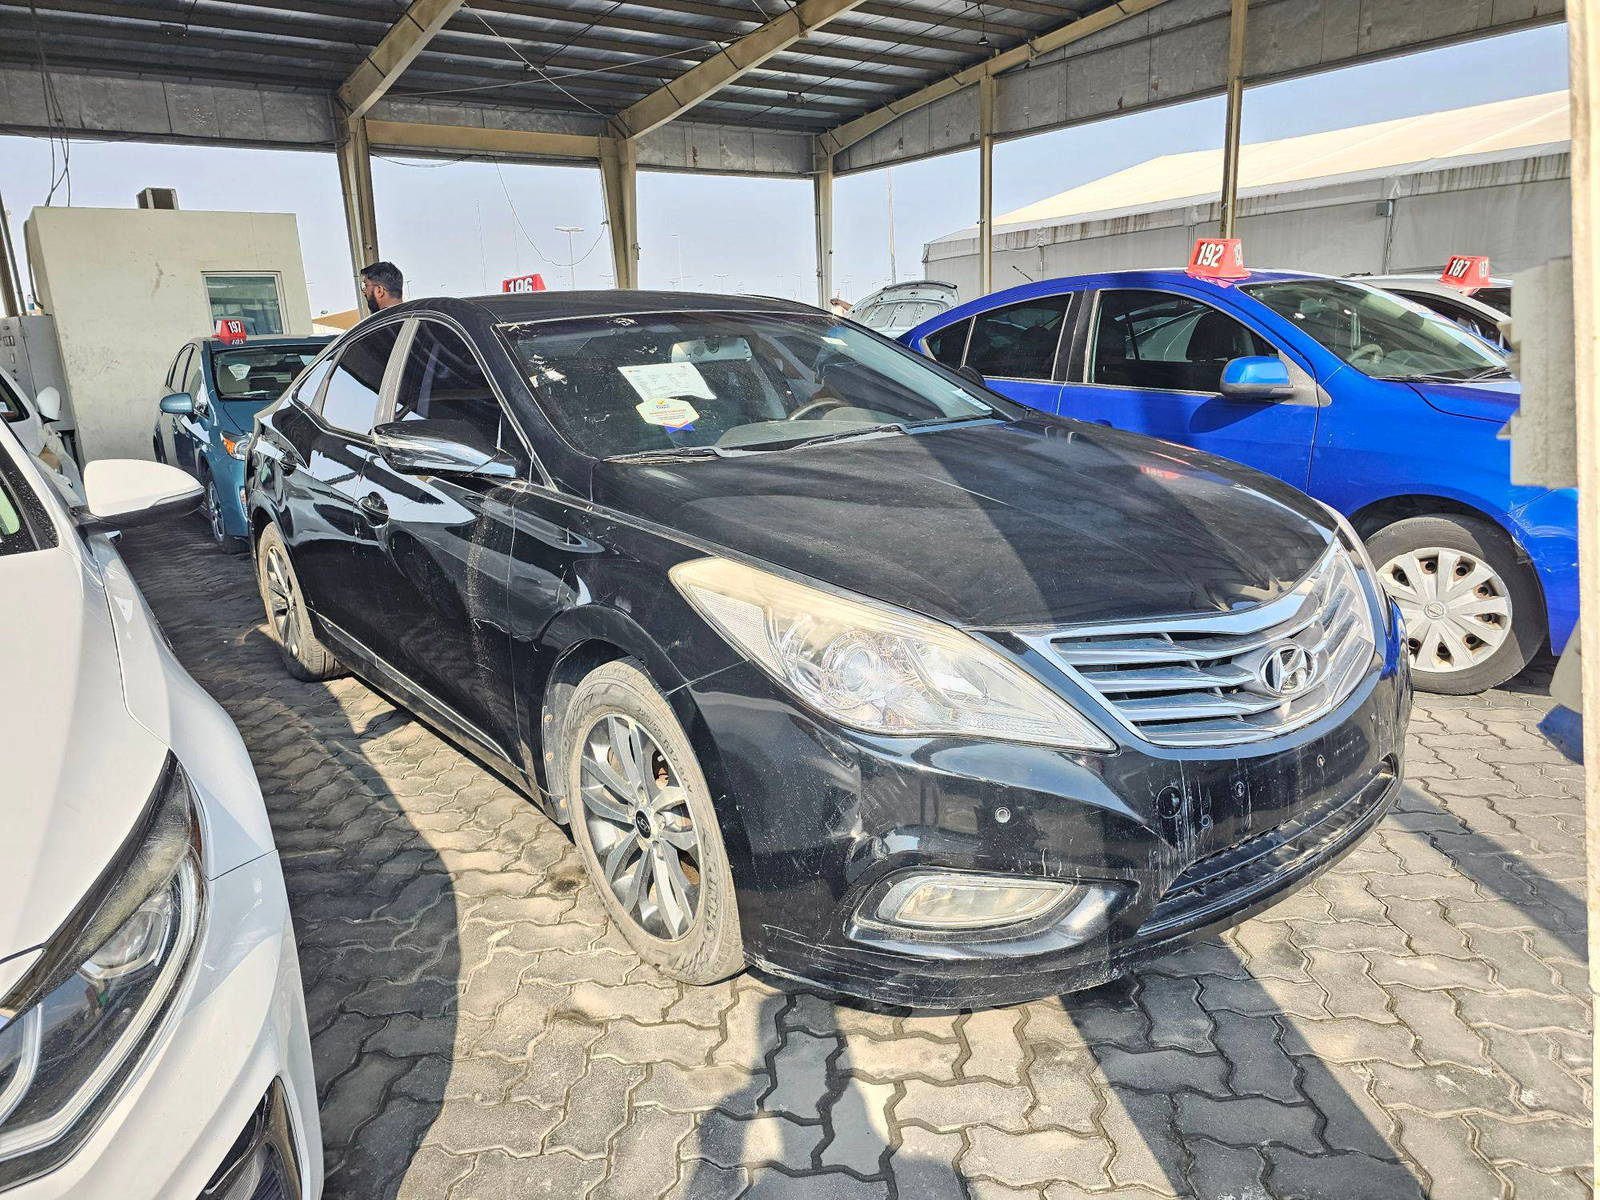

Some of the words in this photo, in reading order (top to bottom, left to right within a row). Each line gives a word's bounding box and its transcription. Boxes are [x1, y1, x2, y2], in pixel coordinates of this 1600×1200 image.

[1196, 241, 1226, 268] 192
[1447, 258, 1472, 279] 187
[508, 277, 533, 293] 196
[227, 320, 242, 334] 197
